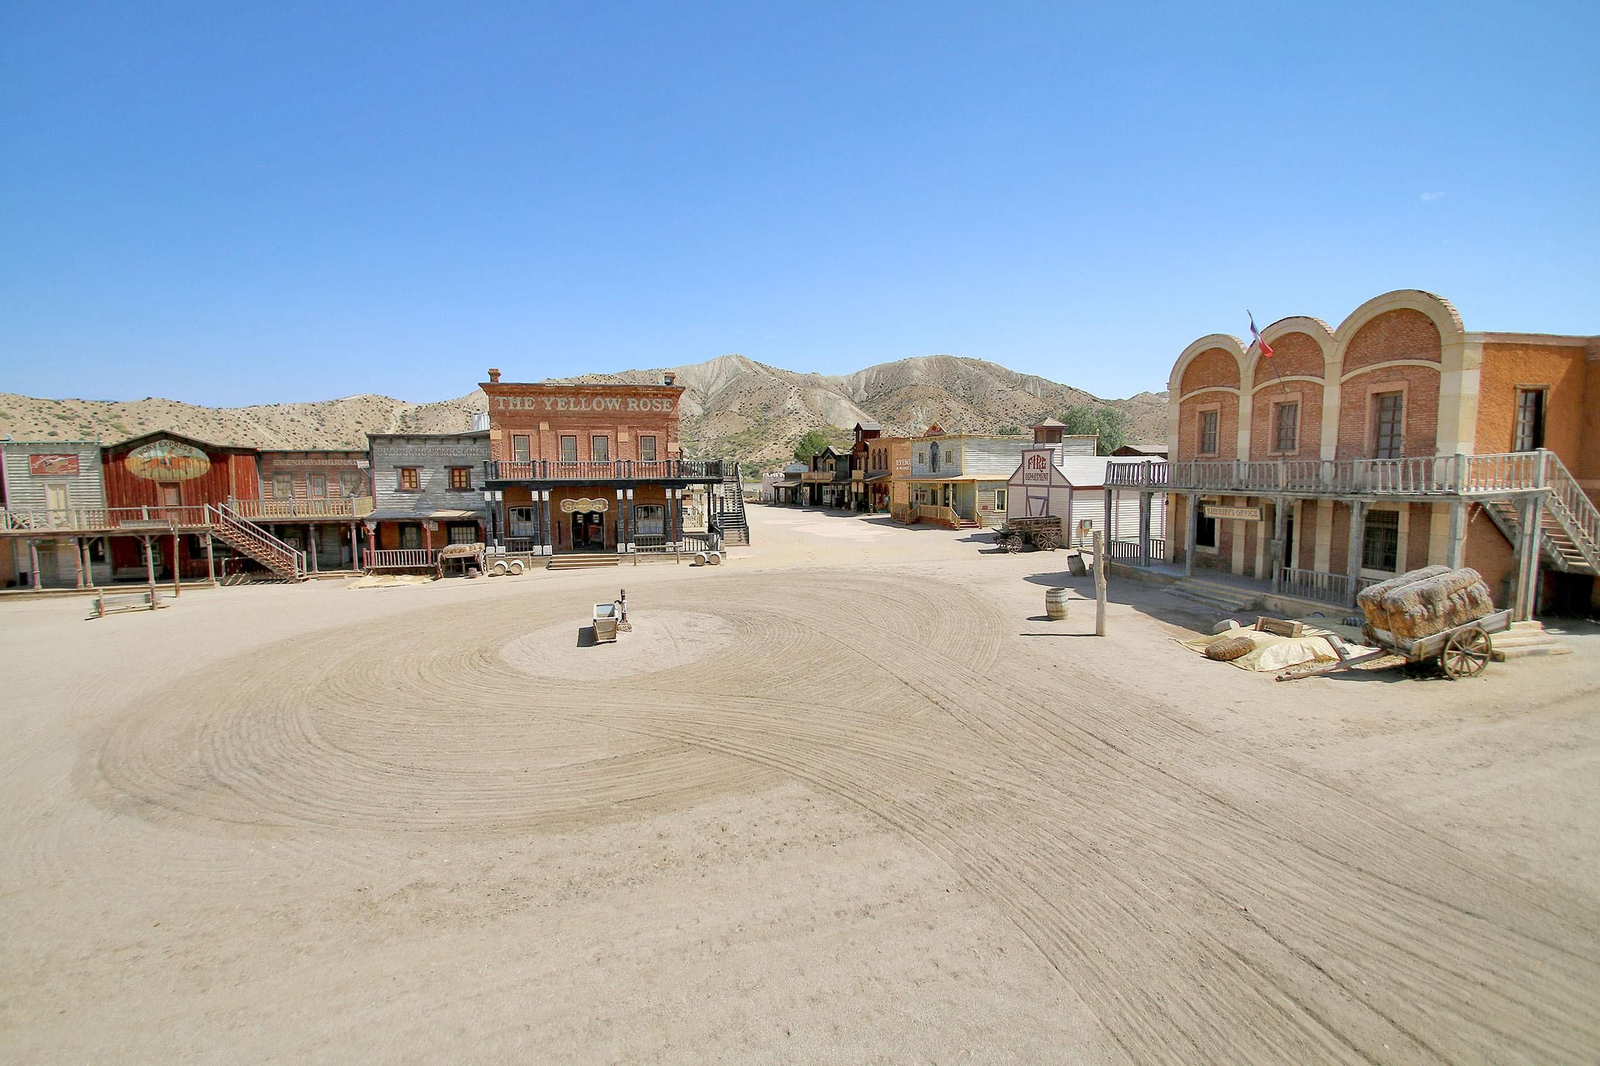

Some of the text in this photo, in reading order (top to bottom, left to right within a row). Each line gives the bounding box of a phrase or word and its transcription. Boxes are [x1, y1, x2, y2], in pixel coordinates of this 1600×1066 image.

[494, 396, 674, 412] THE YELLOW ROSE
[137, 441, 194, 456] PONY EXPRESS
[1027, 454, 1047, 473] FIRE
[1025, 472, 1049, 482] DEPARTMENT
[1235, 509, 1259, 518] OFFICE
